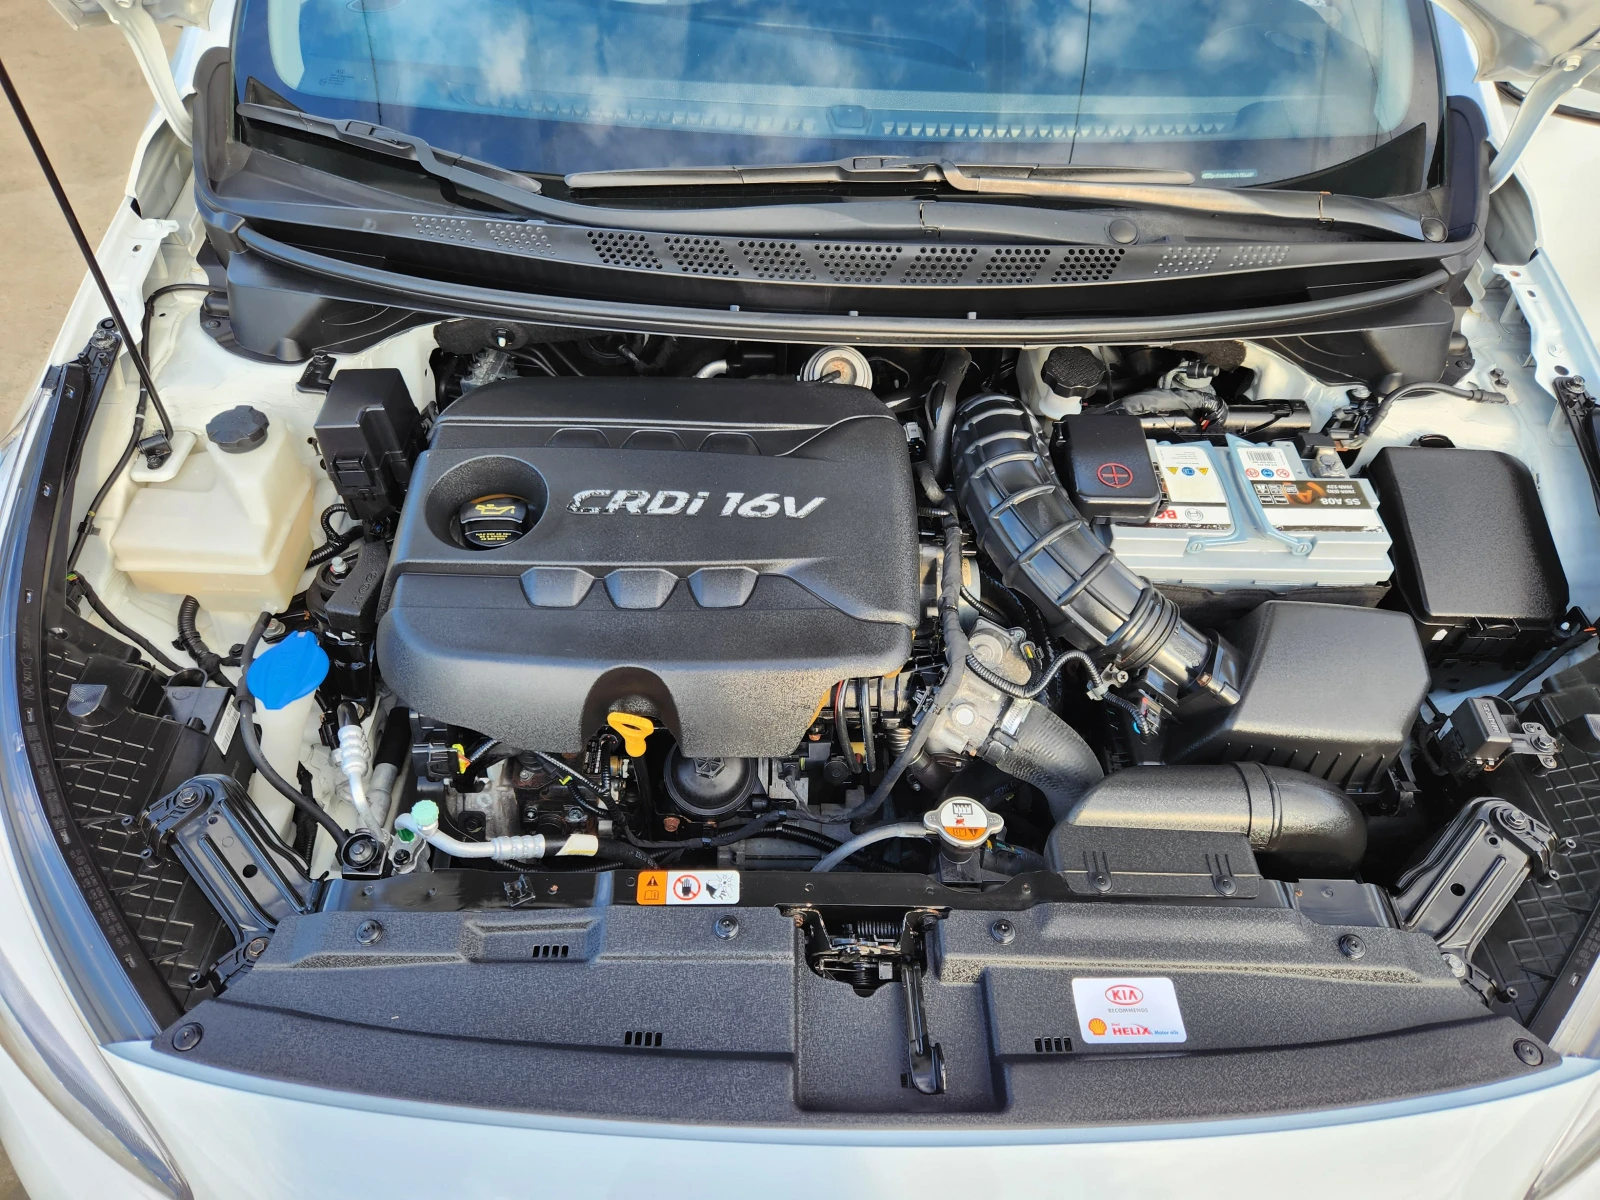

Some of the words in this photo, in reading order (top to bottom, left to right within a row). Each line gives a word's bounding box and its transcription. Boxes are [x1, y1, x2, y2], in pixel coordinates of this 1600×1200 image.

[566, 489, 710, 517] CRDi
[719, 492, 827, 519] 16V
[1112, 989, 1139, 1001] KIA
[1112, 1026, 1153, 1036] HELIX
